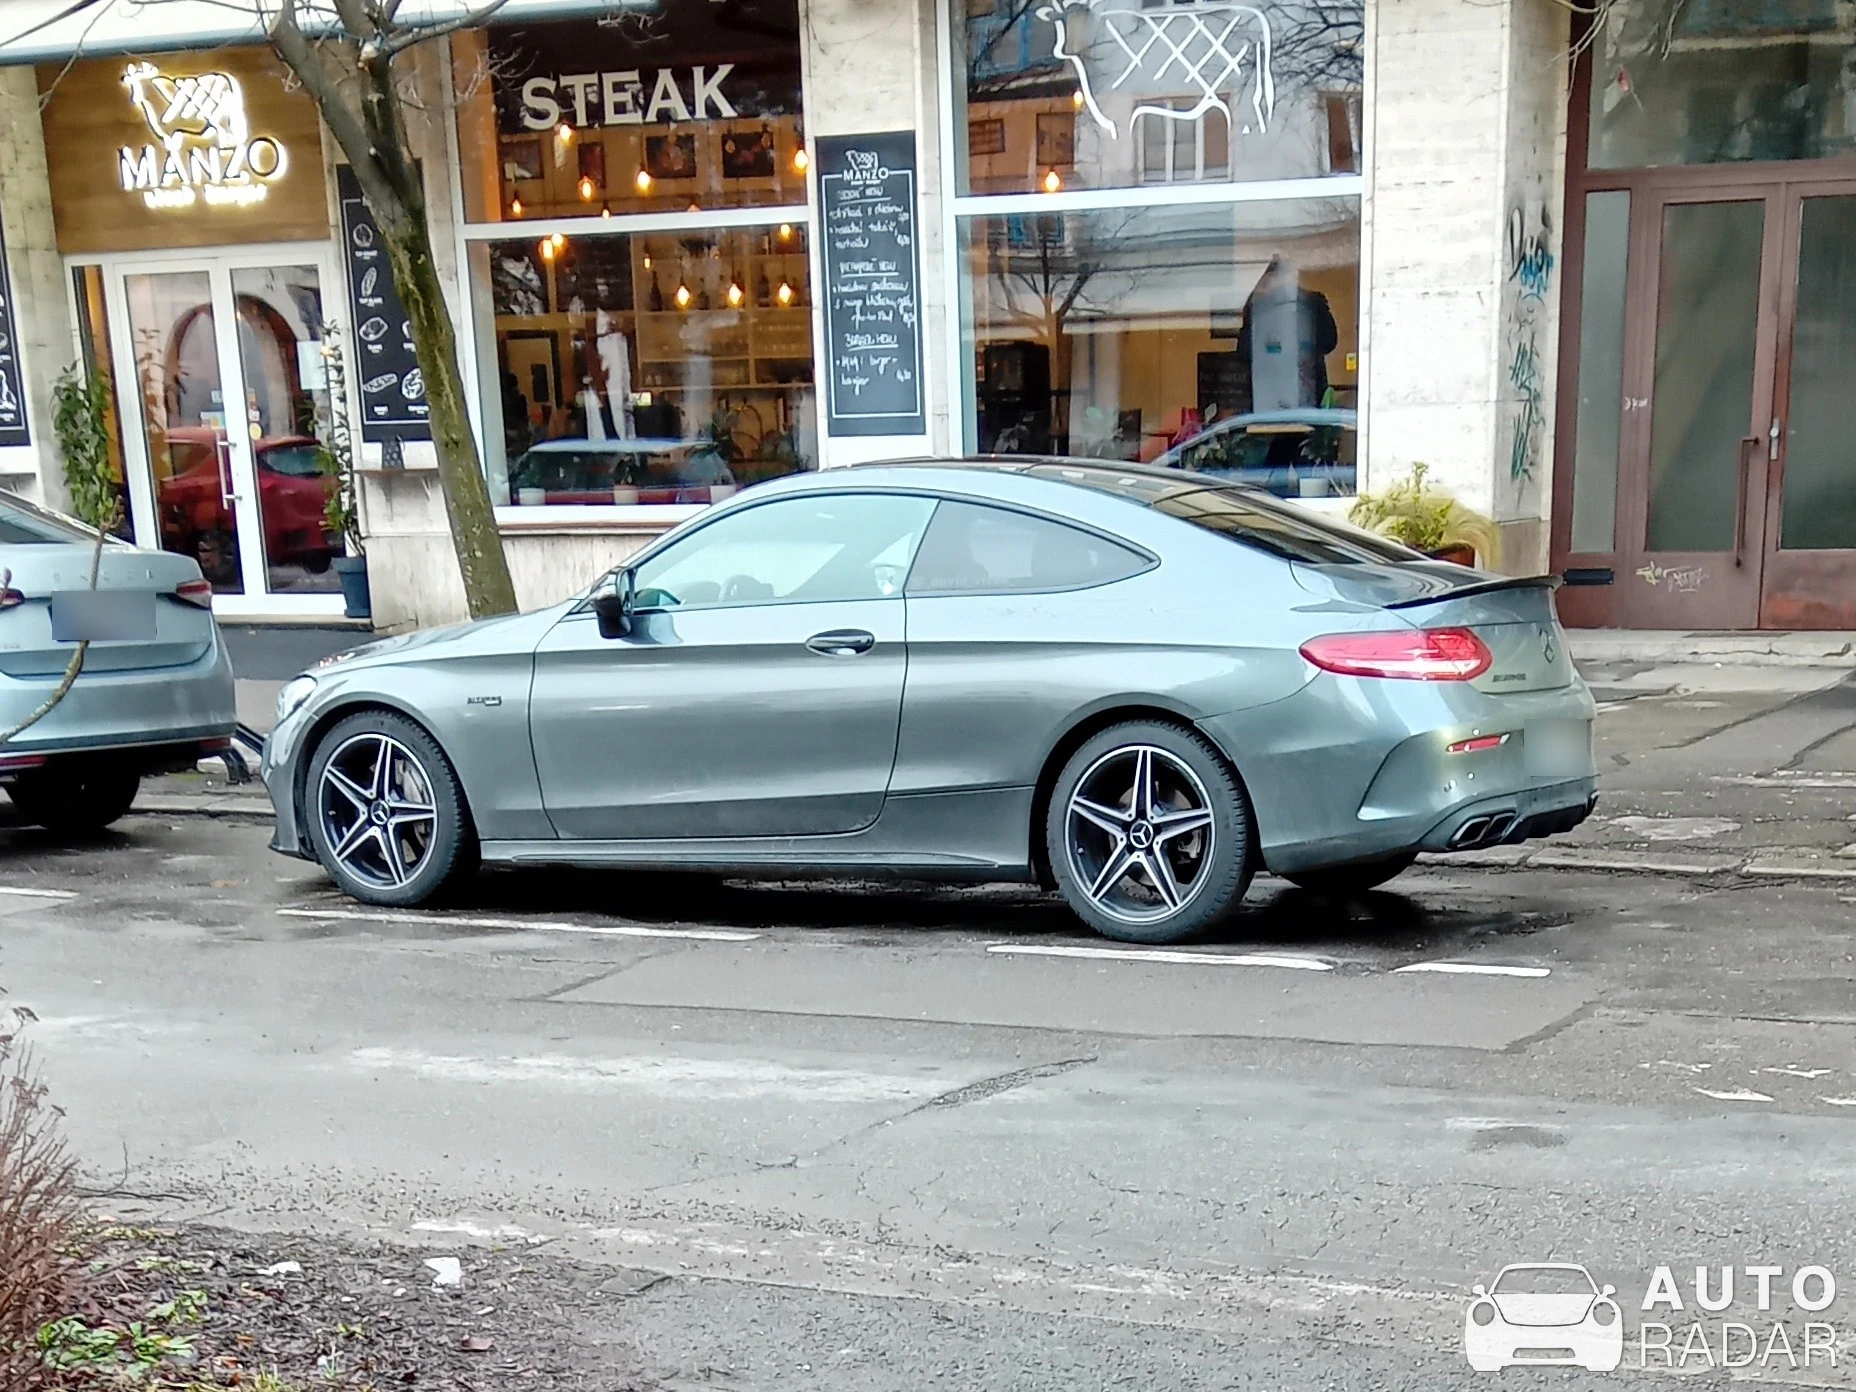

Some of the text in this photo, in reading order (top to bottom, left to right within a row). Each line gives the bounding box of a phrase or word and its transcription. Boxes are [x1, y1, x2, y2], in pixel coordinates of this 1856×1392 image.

[522, 64, 738, 130] STEAK
[118, 137, 287, 190] MANZO
[843, 167, 889, 181] MANZO
